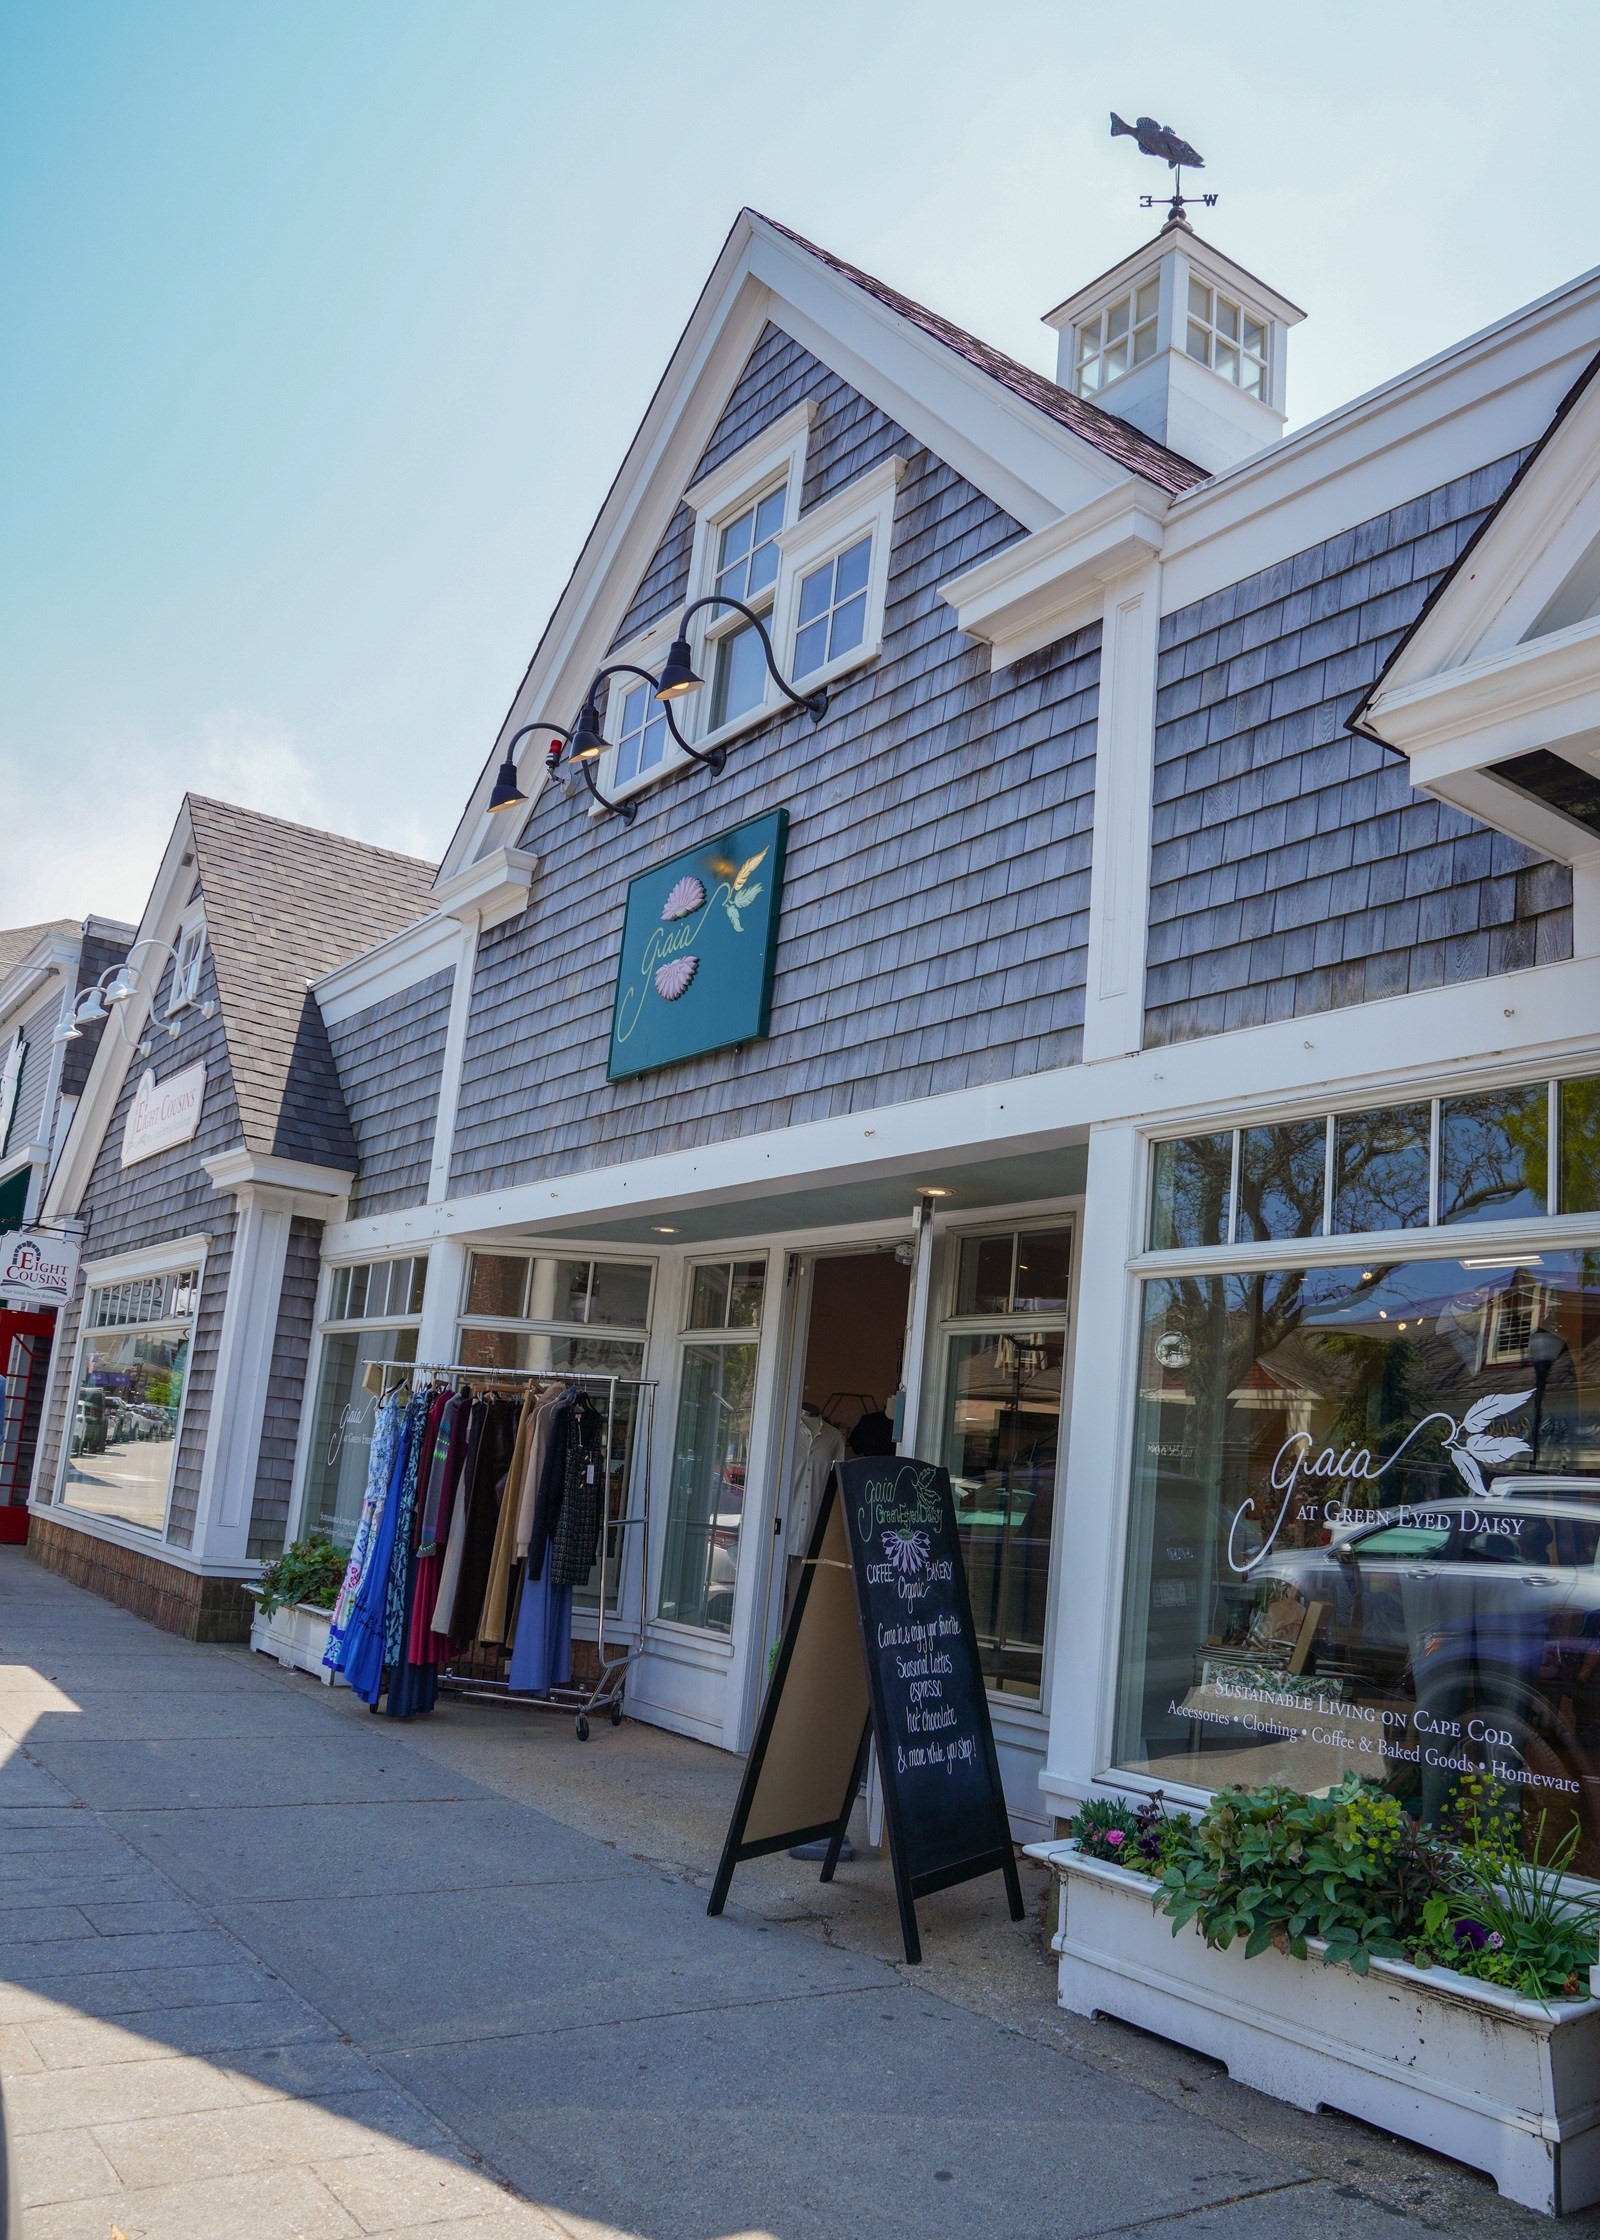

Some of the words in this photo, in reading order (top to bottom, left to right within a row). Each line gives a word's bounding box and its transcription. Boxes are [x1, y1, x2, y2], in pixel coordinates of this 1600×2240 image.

[1202, 194, 1219, 207] W
[6, 1265, 68, 1287] COUSINS
[1228, 1424, 1410, 1573] gaia
[1296, 1505, 1318, 1521] AT
[1324, 1500, 1391, 1526] GREEN
[1397, 1504, 1451, 1531] EYED
[1458, 1508, 1526, 1536] DAISY
[866, 1563, 895, 1585] COFFEE
[925, 1560, 953, 1581] BAKERY
[898, 1575, 931, 1614] Organic
[878, 1622, 897, 1649] Come
[910, 1620, 927, 1654] enjoy
[909, 1679, 943, 1710] espresso
[905, 1705, 921, 1733] hot
[921, 1703, 958, 1732] chocolate
[1214, 1676, 1313, 1712] SUSTAINABLE
[1318, 1694, 1377, 1722] LIVING
[1381, 1710, 1408, 1728] ON
[1413, 1710, 1462, 1738] CAPE
[1467, 1719, 1514, 1746] COD
[897, 1745, 908, 1774] &
[908, 1748, 927, 1767] more
[1167, 1699, 1230, 1726] Accessories
[1242, 1713, 1299, 1744] Clothing
[1311, 1726, 1356, 1751] Coffee
[1358, 1735, 1373, 1753] &
[1378, 1738, 1421, 1763] Baked
[1425, 1748, 1475, 1773] Goods
[1491, 1759, 1581, 1794] Homeware
